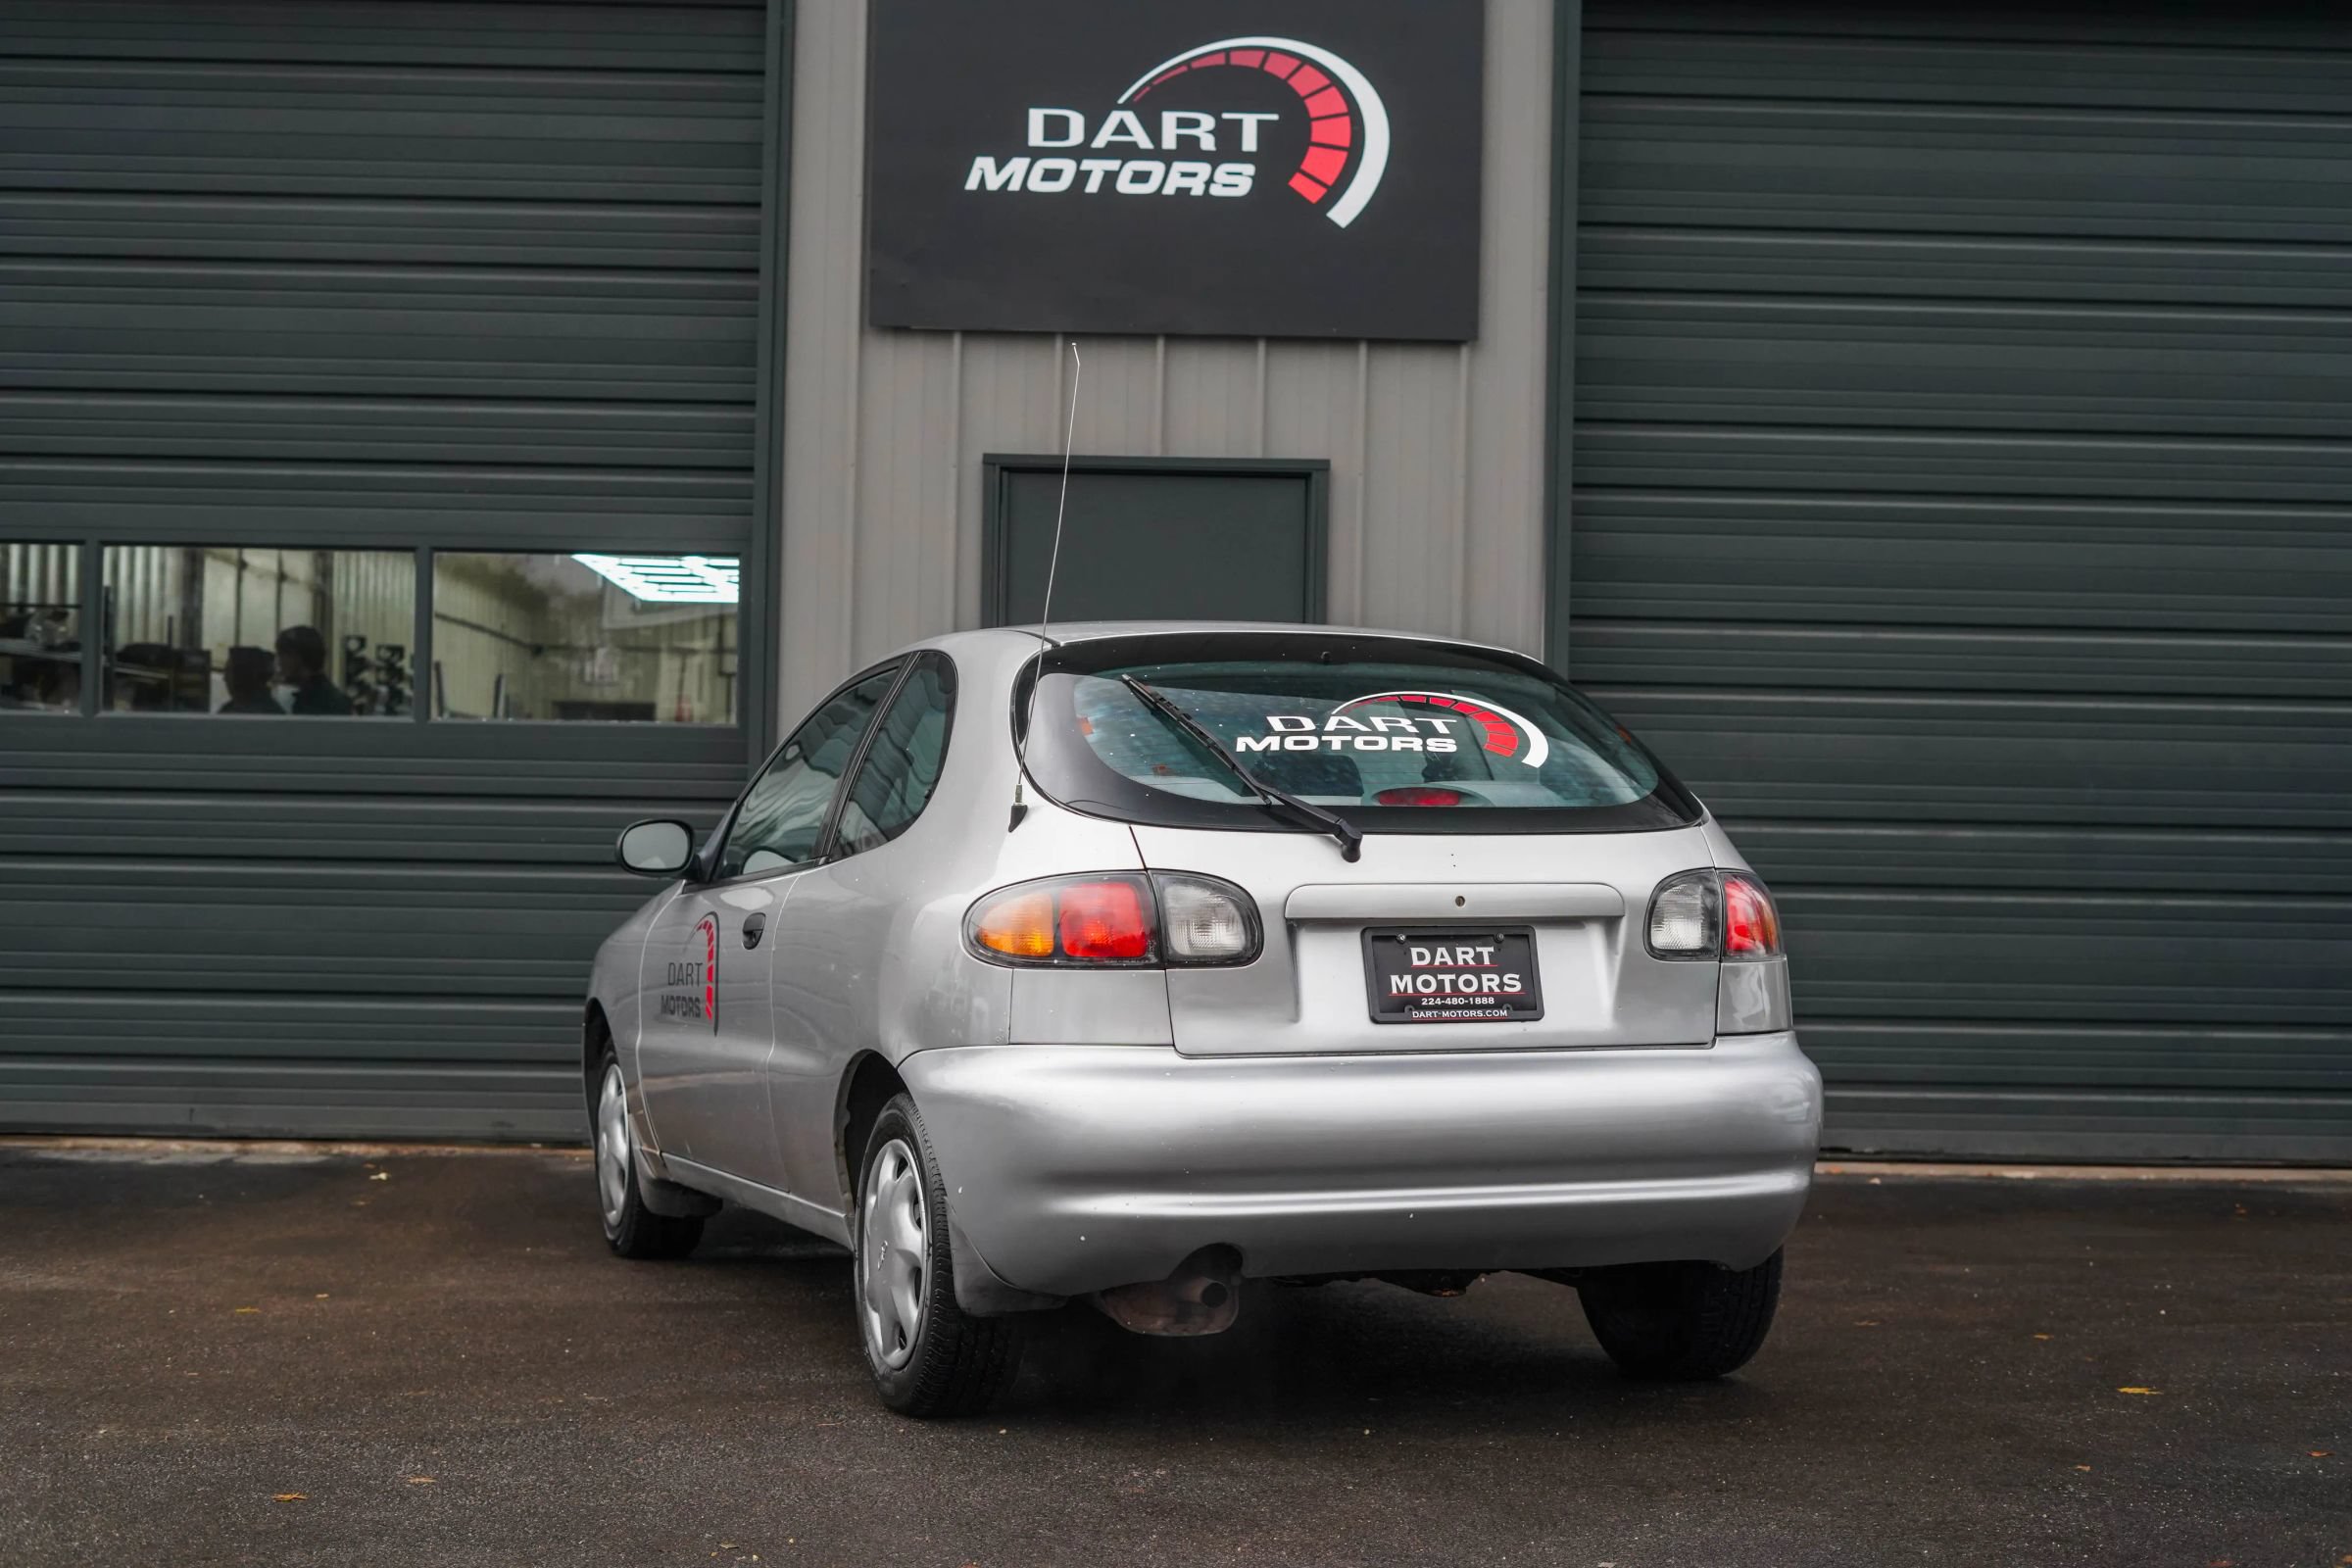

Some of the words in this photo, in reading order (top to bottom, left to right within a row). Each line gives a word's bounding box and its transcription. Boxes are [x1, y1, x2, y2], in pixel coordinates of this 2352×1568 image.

[1028, 108, 1279, 152] DART
[964, 157, 1255, 197] MOTORS
[1265, 715, 1457, 734] DART
[1236, 736, 1457, 753] MOTORS
[1409, 946, 1494, 965] DART
[667, 962, 703, 987] DART
[1390, 973, 1522, 994] MOTORS
[661, 995, 702, 1018] MOTORS
[1421, 997, 1495, 1005] 224-480-1888
[1412, 1009, 1508, 1018] DART-MOTORS.COM
